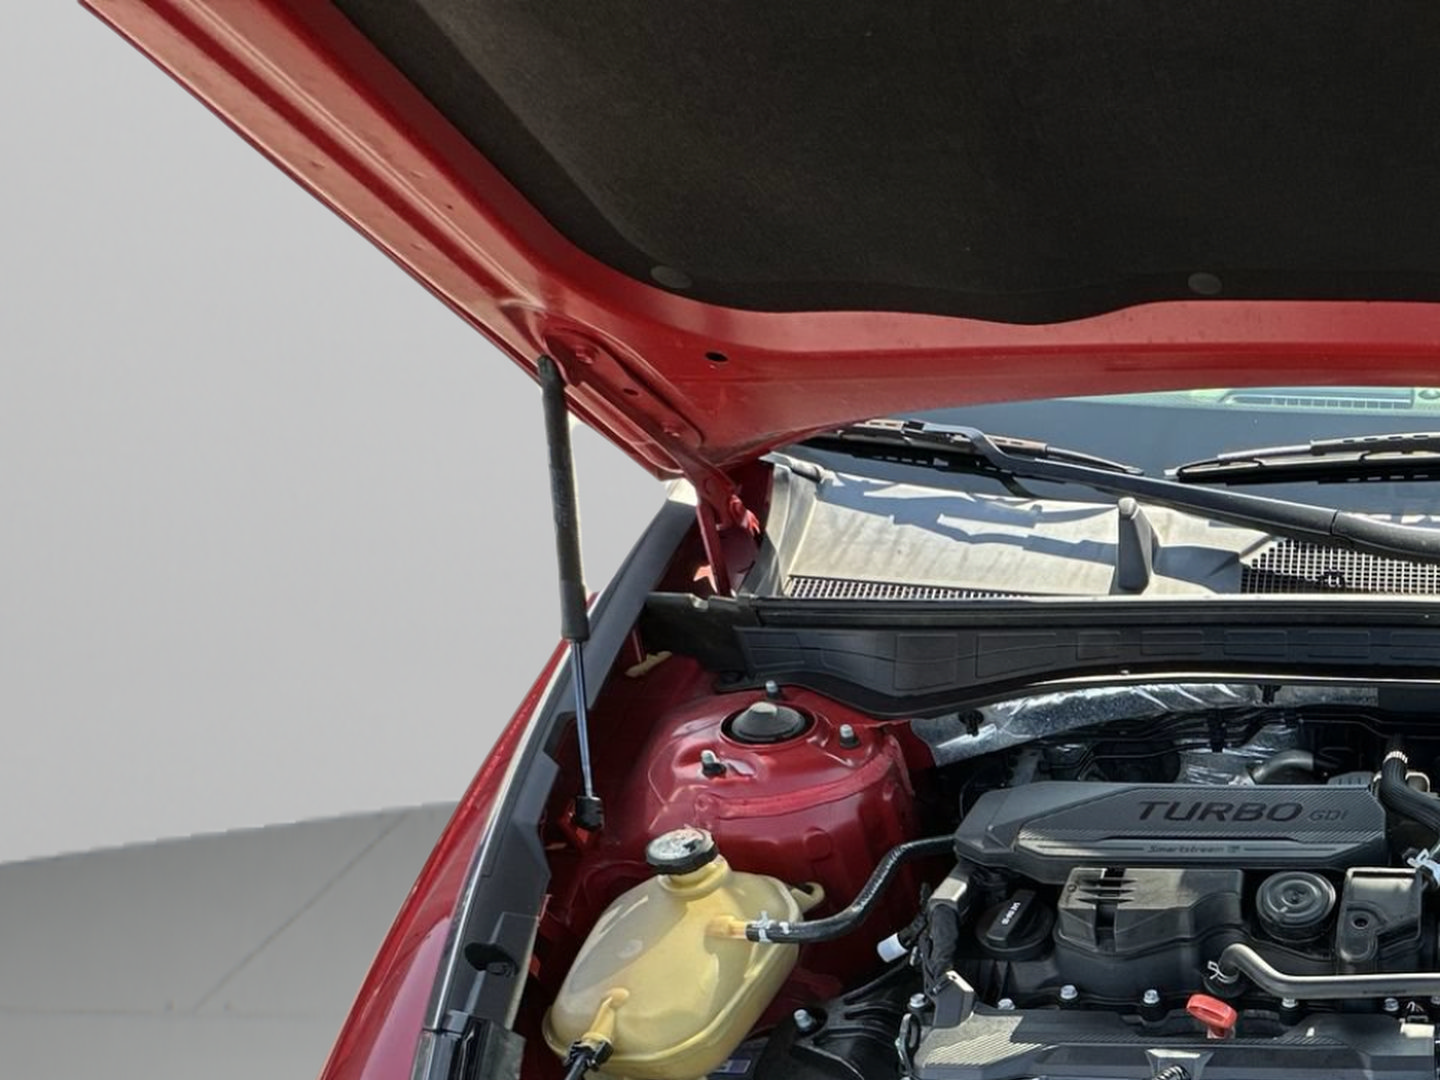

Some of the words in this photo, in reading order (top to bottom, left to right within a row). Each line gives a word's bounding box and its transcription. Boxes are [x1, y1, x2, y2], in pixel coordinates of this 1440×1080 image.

[1138, 801, 1304, 822] TURBO
[1308, 809, 1350, 821] GDI
[1147, 844, 1224, 854] Smartstream
